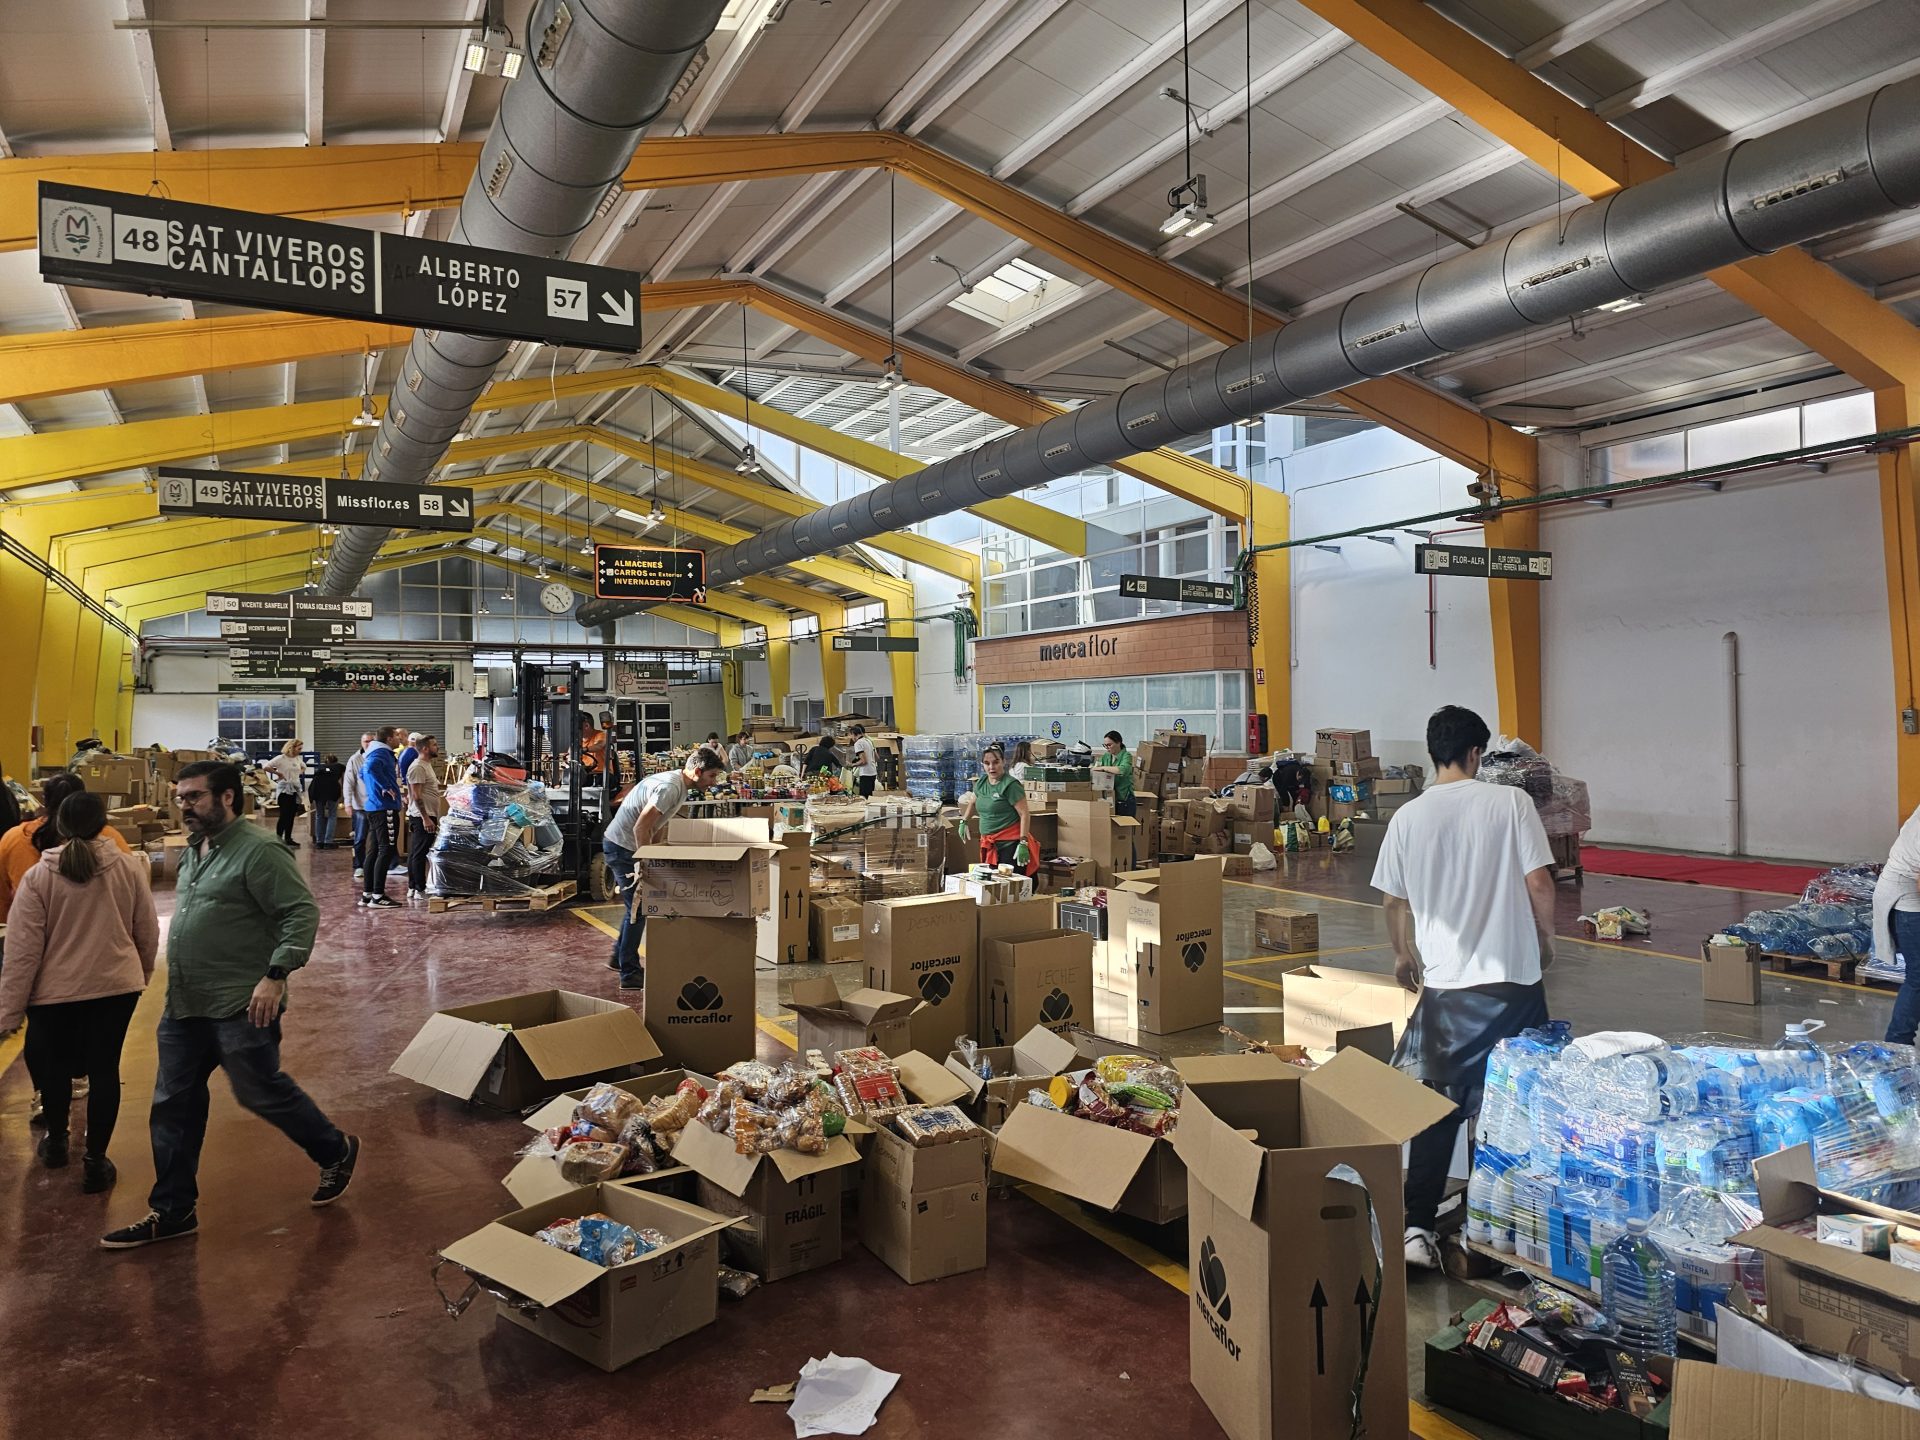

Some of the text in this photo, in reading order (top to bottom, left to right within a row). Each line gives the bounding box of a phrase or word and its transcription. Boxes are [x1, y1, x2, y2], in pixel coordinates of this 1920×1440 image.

[122, 228, 160, 252] 48
[167, 220, 365, 270] SAT VIVEROS
[167, 245, 366, 294] CANTALLOPS
[418, 255, 520, 289] ALBERTO
[437, 282, 508, 314] LÓPEZ
[553, 288, 582, 309] 57
[200, 485, 219, 498] 49
[222, 481, 323, 498] SAT VIVEROS
[222, 493, 324, 510] CANTALLOPS
[337, 494, 410, 511] Missflor.es
[423, 499, 440, 511] 58
[614, 560, 664, 569] ALMACENES
[1439, 555, 1448, 564] 65
[1452, 555, 1485, 566] FLOR-ALFA
[1530, 561, 1538, 570] 72
[614, 568, 648, 577] CARROS
[614, 577, 672, 587] INVERNADERO
[226, 600, 237, 608] 50
[241, 601, 289, 609] VICENTE SANFELIX
[296, 602, 341, 611] TOMAS IGLESIAS
[344, 604, 354, 612] 59
[1039, 634, 1118, 661] mercaflor
[345, 672, 420, 681] Diana Soler
[647, 905, 659, 913] 80
[1175, 928, 1212, 942] mercaflor
[910, 955, 961, 971] mercaflor
[1036, 966, 1080, 989] LECHE
[667, 1012, 733, 1025] mercaflor
[784, 1203, 827, 1226] FRÁGIL
[1681, 1261, 1710, 1276] ENTERA
[1195, 1290, 1242, 1362] mercaflor
